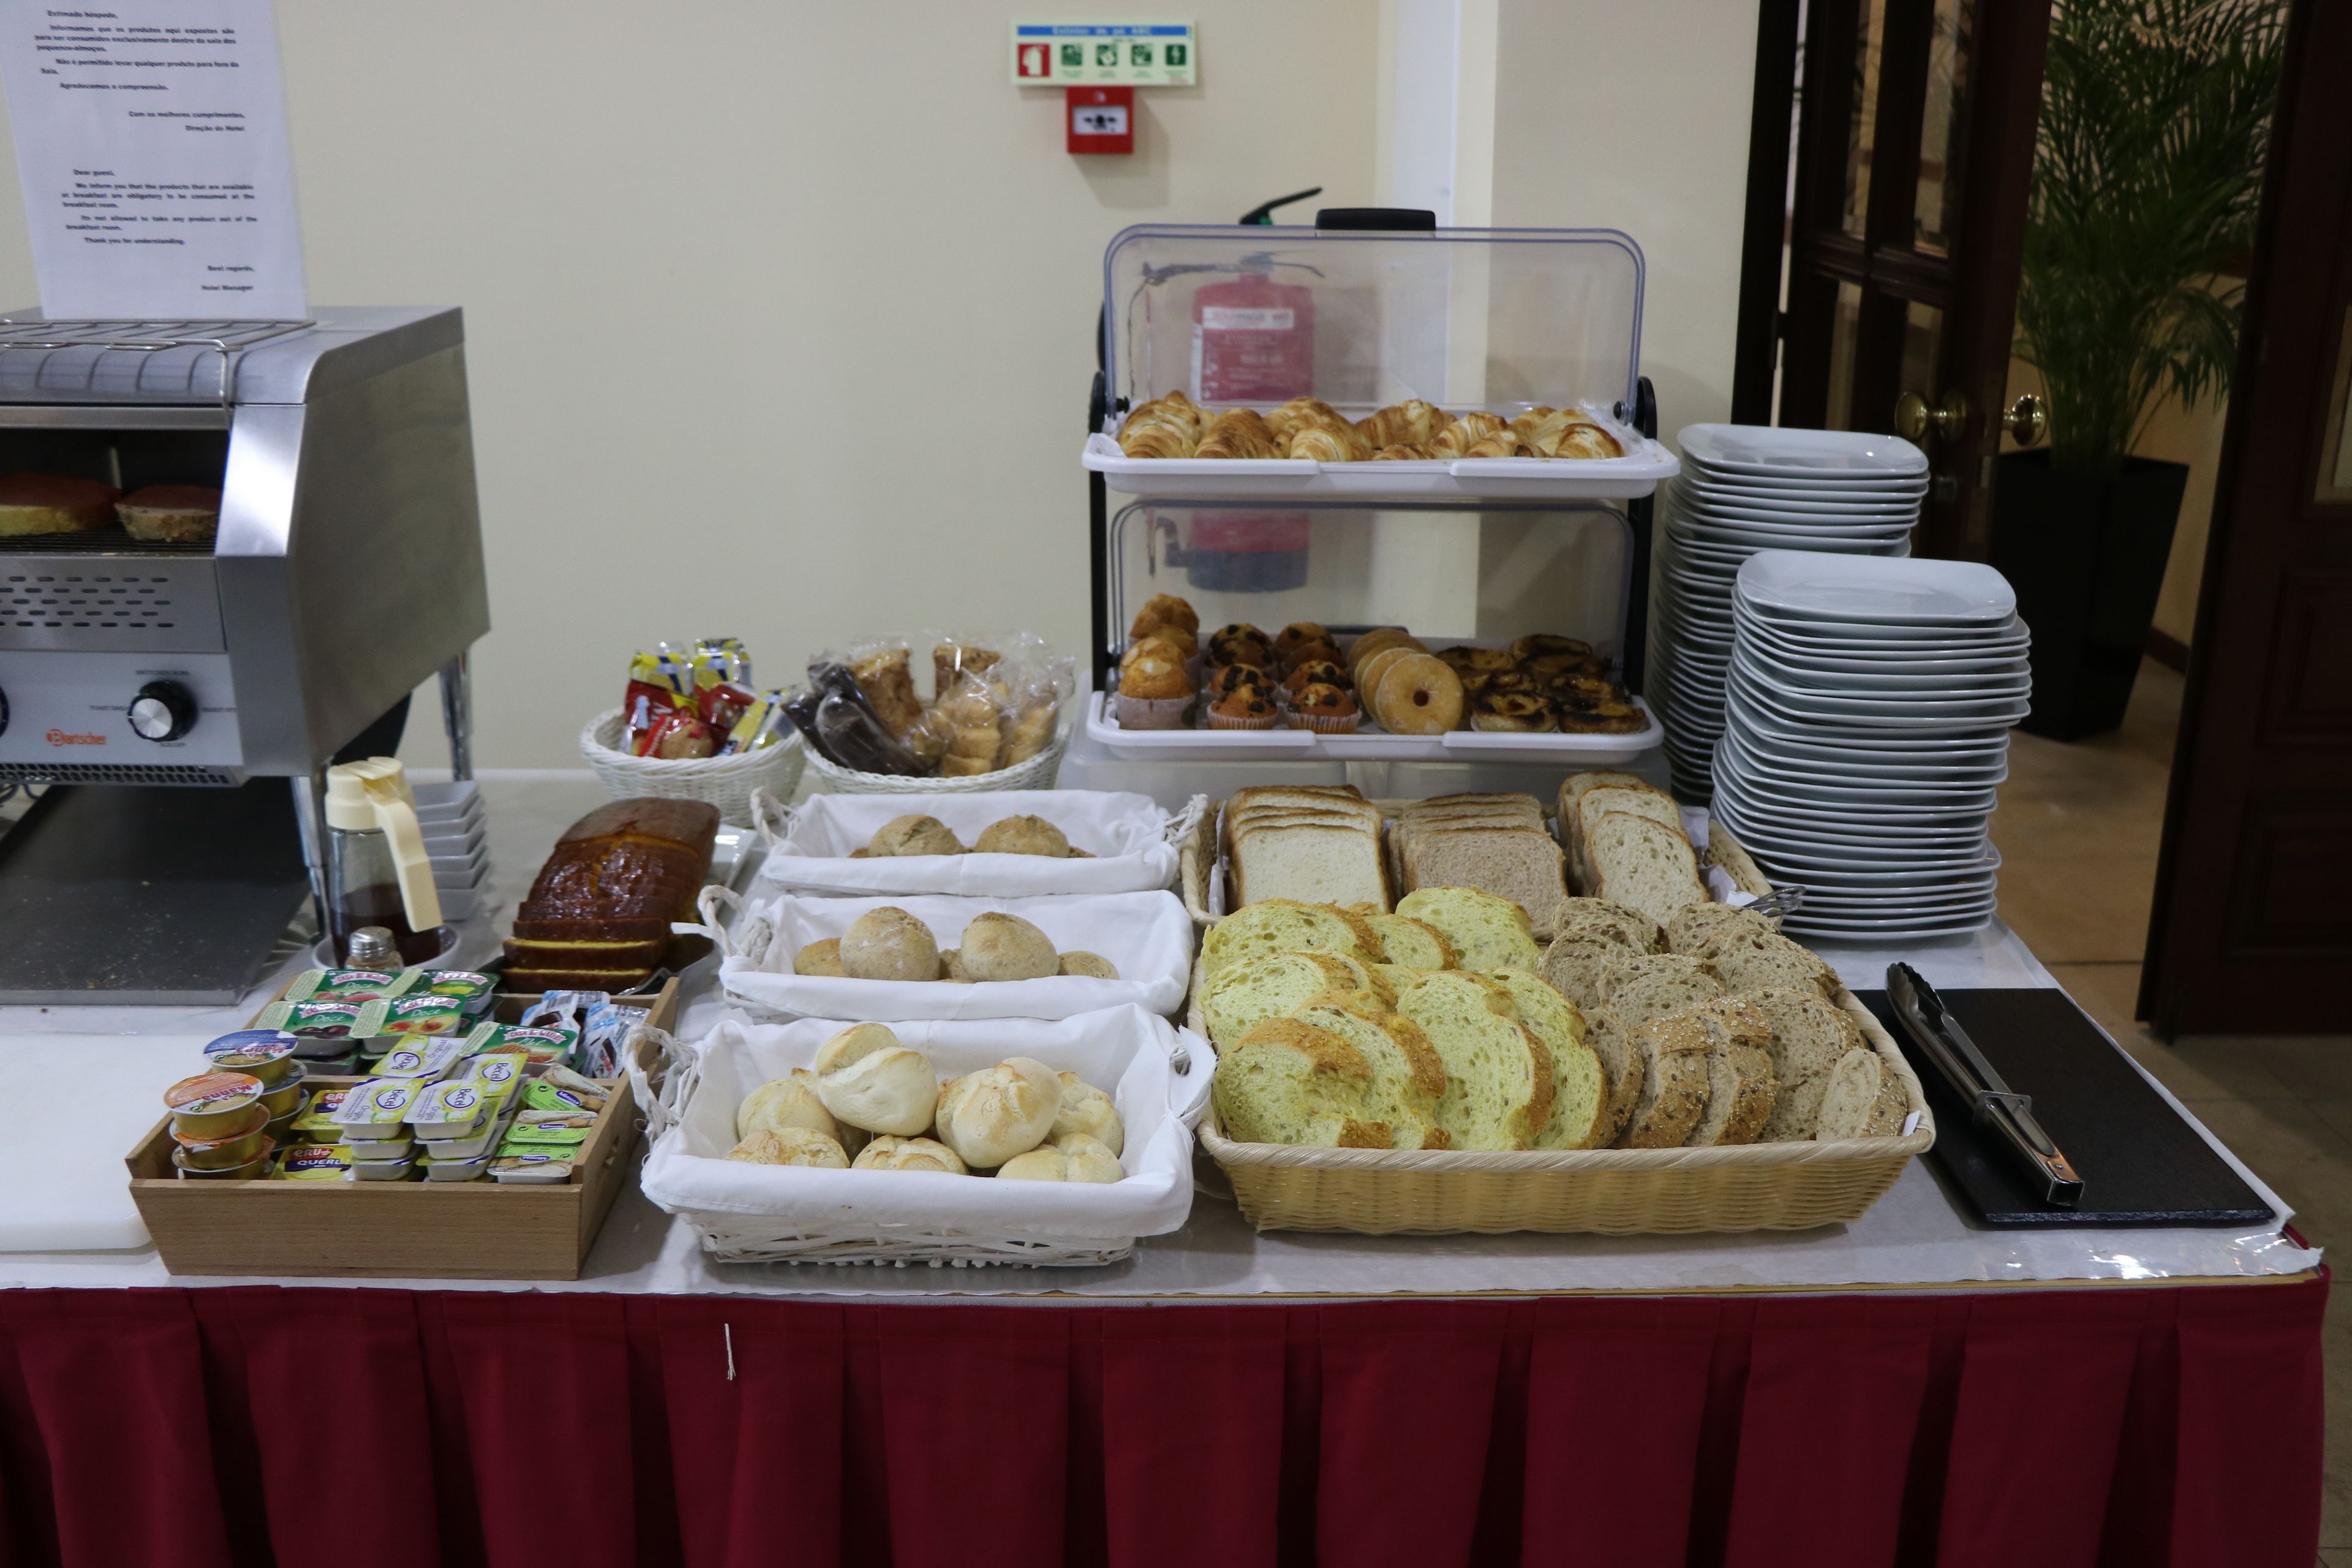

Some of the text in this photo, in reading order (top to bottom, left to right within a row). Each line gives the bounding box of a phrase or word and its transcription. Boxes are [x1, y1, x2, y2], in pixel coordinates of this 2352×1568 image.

[314, 1014, 345, 1022] Doce
[411, 1009, 442, 1017] Doce
[391, 1054, 415, 1070] Becel
[490, 1063, 509, 1079] Becel
[383, 1089, 405, 1106] Becel
[453, 1088, 472, 1106] Becel
[558, 1091, 579, 1105] Mimosa
